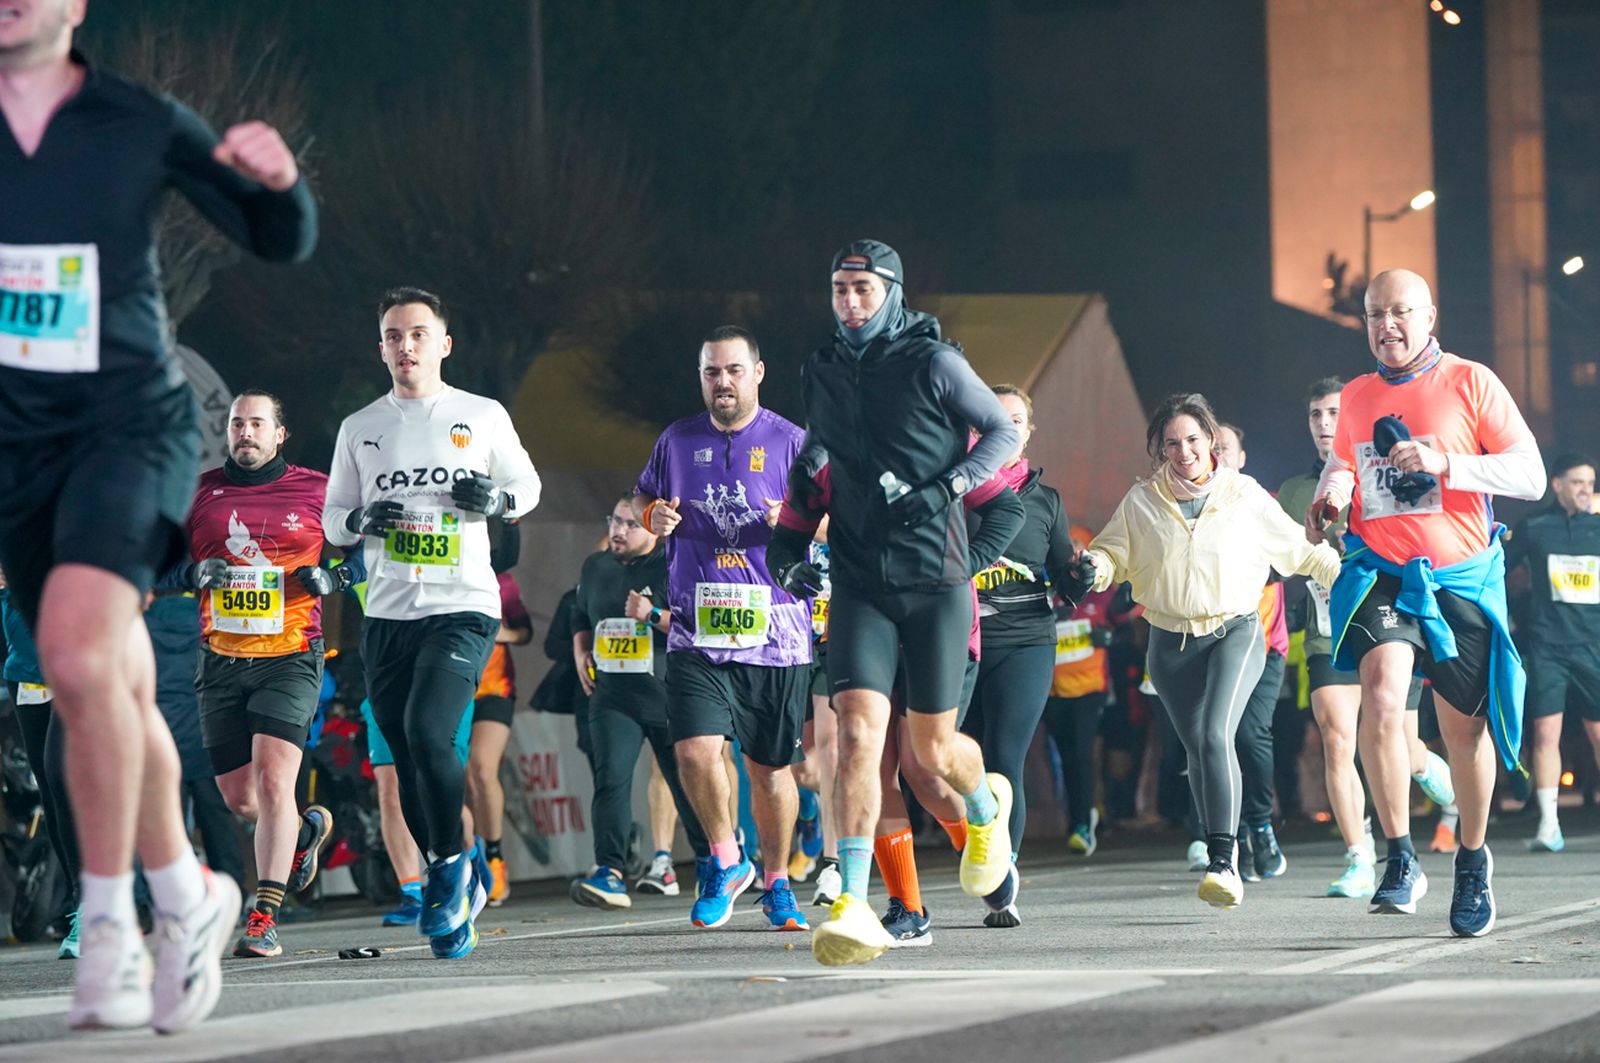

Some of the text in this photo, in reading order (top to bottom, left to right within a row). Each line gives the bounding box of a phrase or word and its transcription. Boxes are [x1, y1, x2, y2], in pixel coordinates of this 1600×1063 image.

[394, 531, 449, 557] 8933
[222, 590, 271, 611] 5499
[702, 599, 717, 607] SAN
[710, 608, 755, 629] 6416
[607, 638, 638, 654] 7721
[518, 752, 560, 792] SAN
